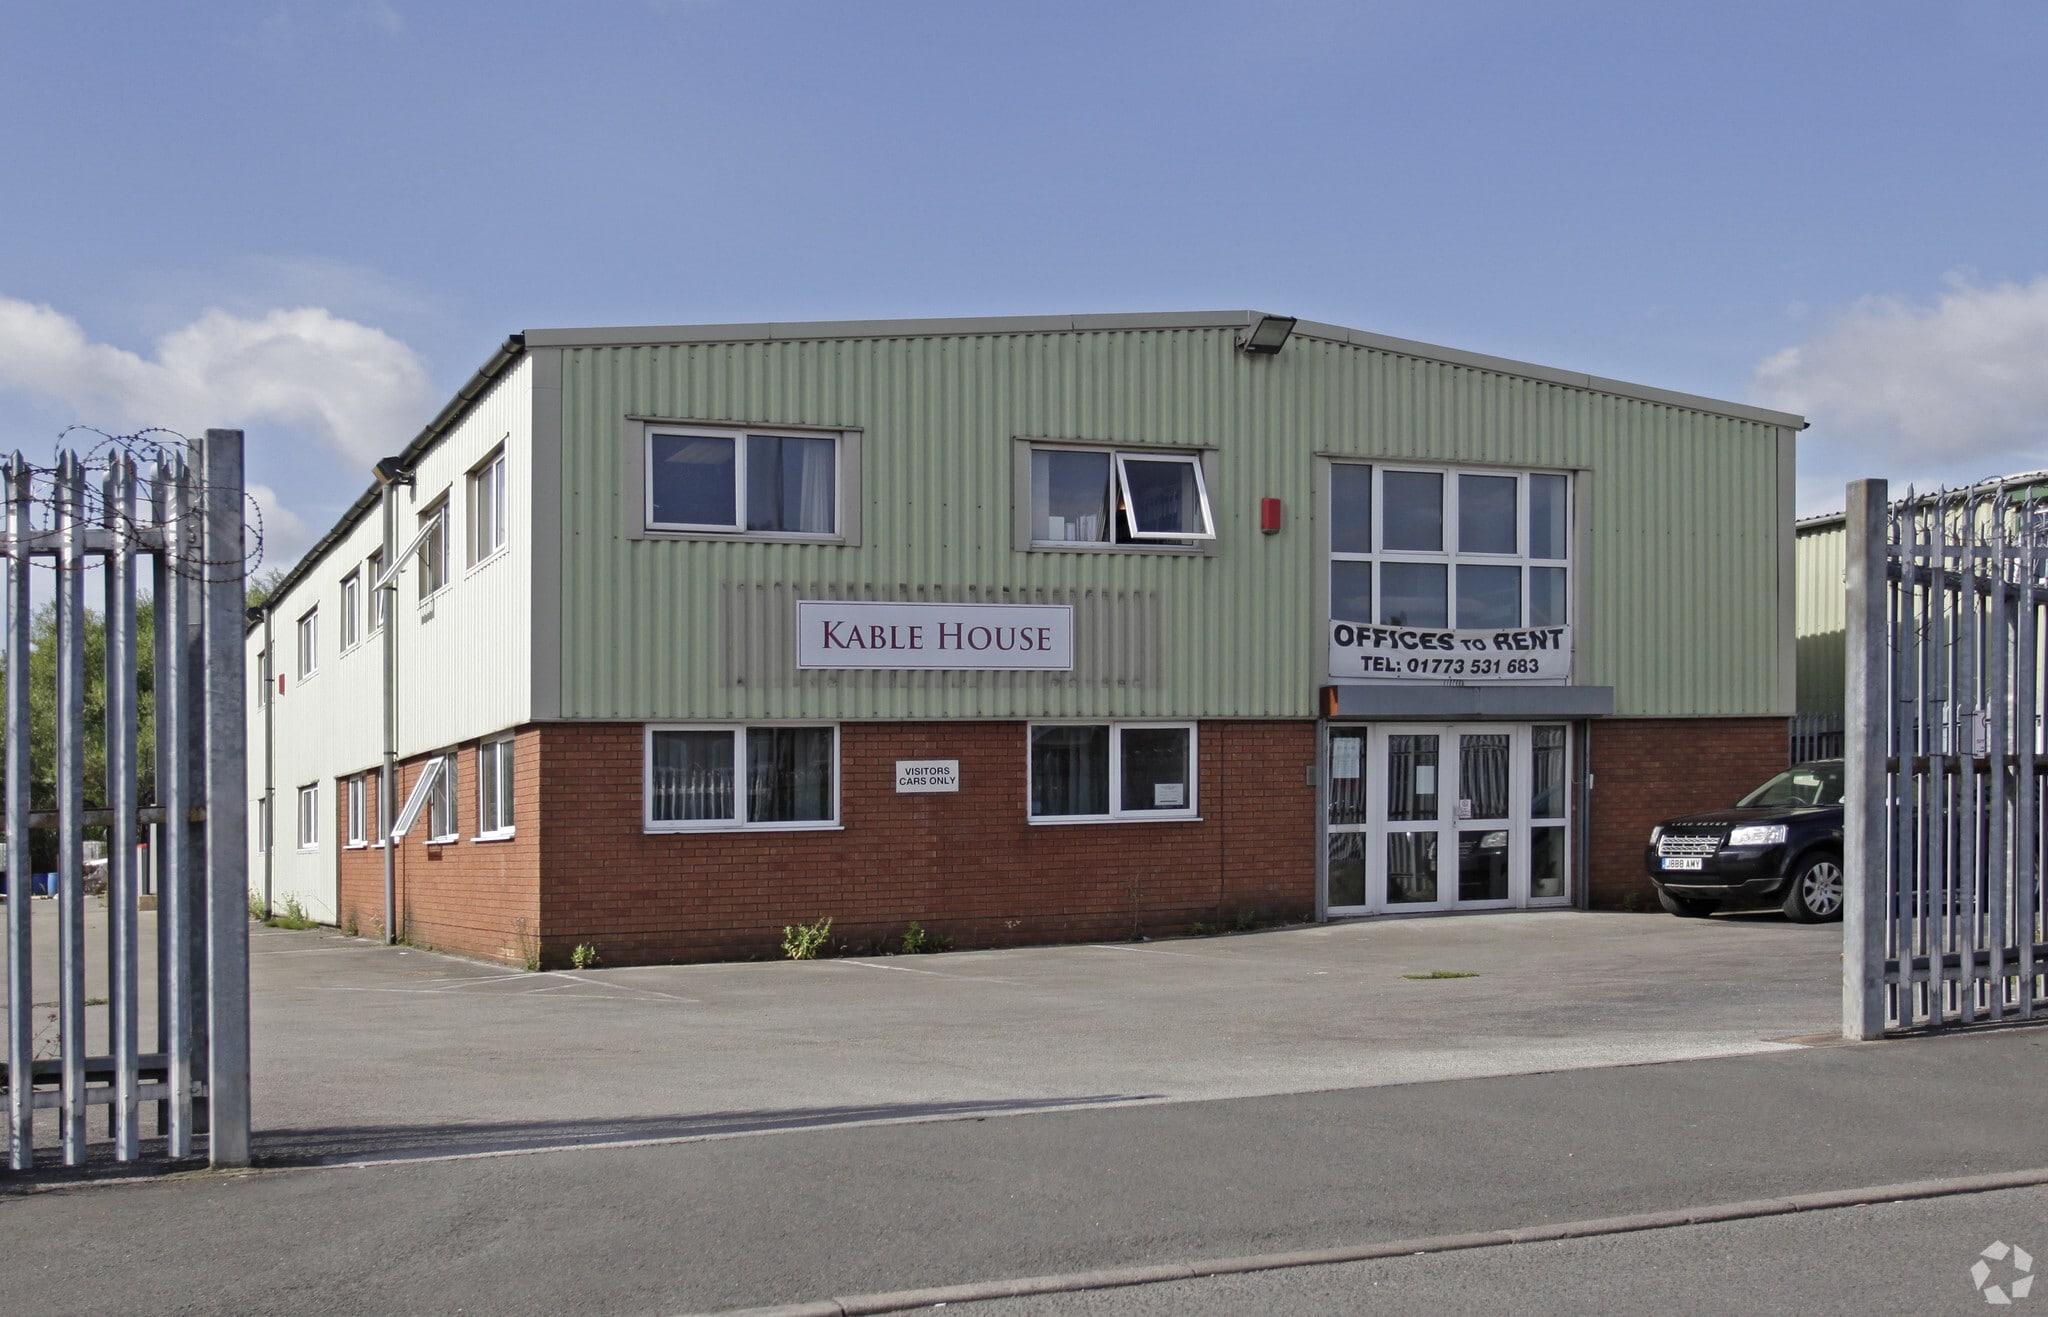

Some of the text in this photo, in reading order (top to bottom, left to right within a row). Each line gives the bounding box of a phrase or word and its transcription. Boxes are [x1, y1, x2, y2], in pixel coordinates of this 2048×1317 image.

[822, 620, 1052, 651] KABLE HOUSE
[1333, 624, 1455, 651] OFFICES
[1493, 628, 1564, 651] RENT
[1360, 655, 1540, 675] TEL: 01773 531 683
[905, 766, 951, 776] VISITORS
[899, 776, 956, 786] CARS ONLY
[1685, 859, 1700, 868] AMY
